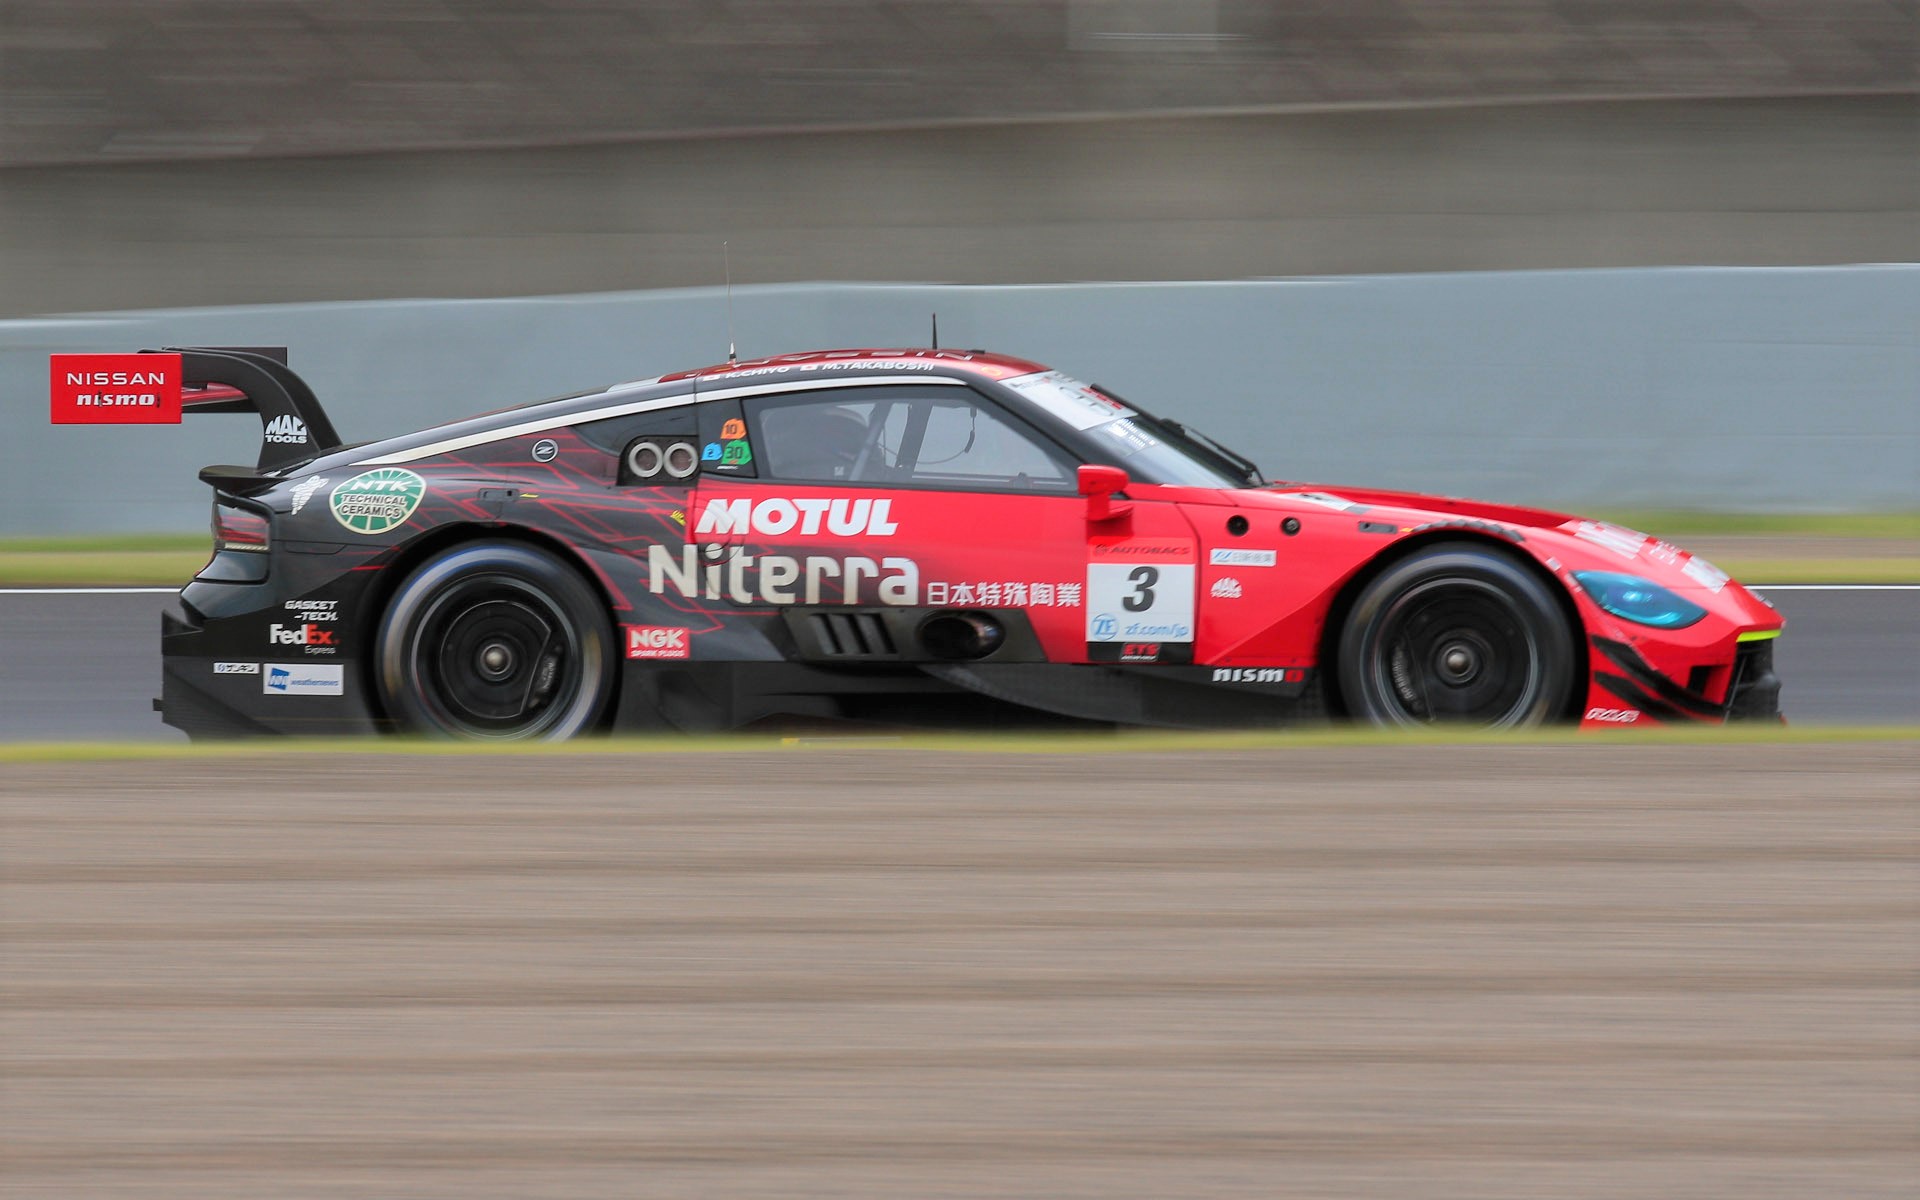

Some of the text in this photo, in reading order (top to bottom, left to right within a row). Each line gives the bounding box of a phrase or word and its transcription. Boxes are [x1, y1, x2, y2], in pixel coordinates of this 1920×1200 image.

[725, 366, 790, 380] K.CHIYO
[822, 361, 936, 372] M.TAKABOSHI
[66, 372, 165, 385] NISSAN
[76, 392, 156, 406] nismo
[265, 414, 308, 436] MAC
[265, 435, 308, 444] TOOLS
[725, 447, 744, 459] 30
[350, 479, 413, 492] NTK
[342, 494, 407, 506] TECHNICAL
[341, 504, 402, 518] CERAMICS
[694, 498, 900, 537] MOTUL
[1110, 547, 1191, 555] AUTOBACS
[647, 542, 920, 606] Niterra
[926, 582, 1083, 607] 日本特殊陶業
[1122, 566, 1160, 612] 3
[284, 600, 339, 610] GASKET
[270, 623, 334, 645] FedEx
[1124, 622, 1190, 638] zf.com/jp
[630, 629, 684, 649] NGK
[304, 645, 337, 656] Express
[1212, 668, 1305, 683] nismo
